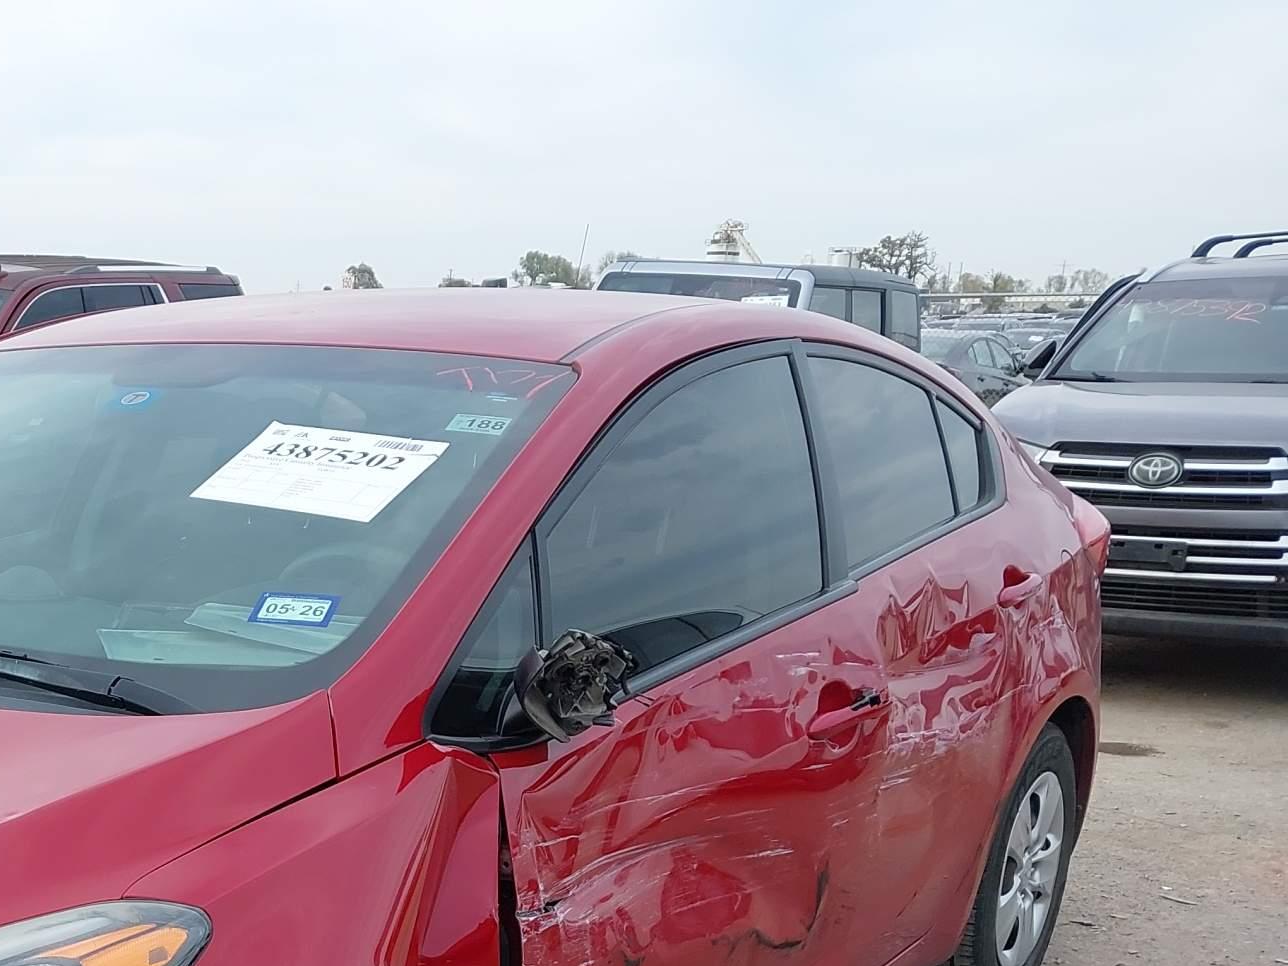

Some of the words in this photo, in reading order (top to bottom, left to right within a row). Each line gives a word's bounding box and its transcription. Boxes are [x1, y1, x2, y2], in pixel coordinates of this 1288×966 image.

[467, 419, 506, 430] 188
[262, 442, 406, 471] 43875202
[266, 604, 290, 614] 05
[299, 605, 325, 617] 26
